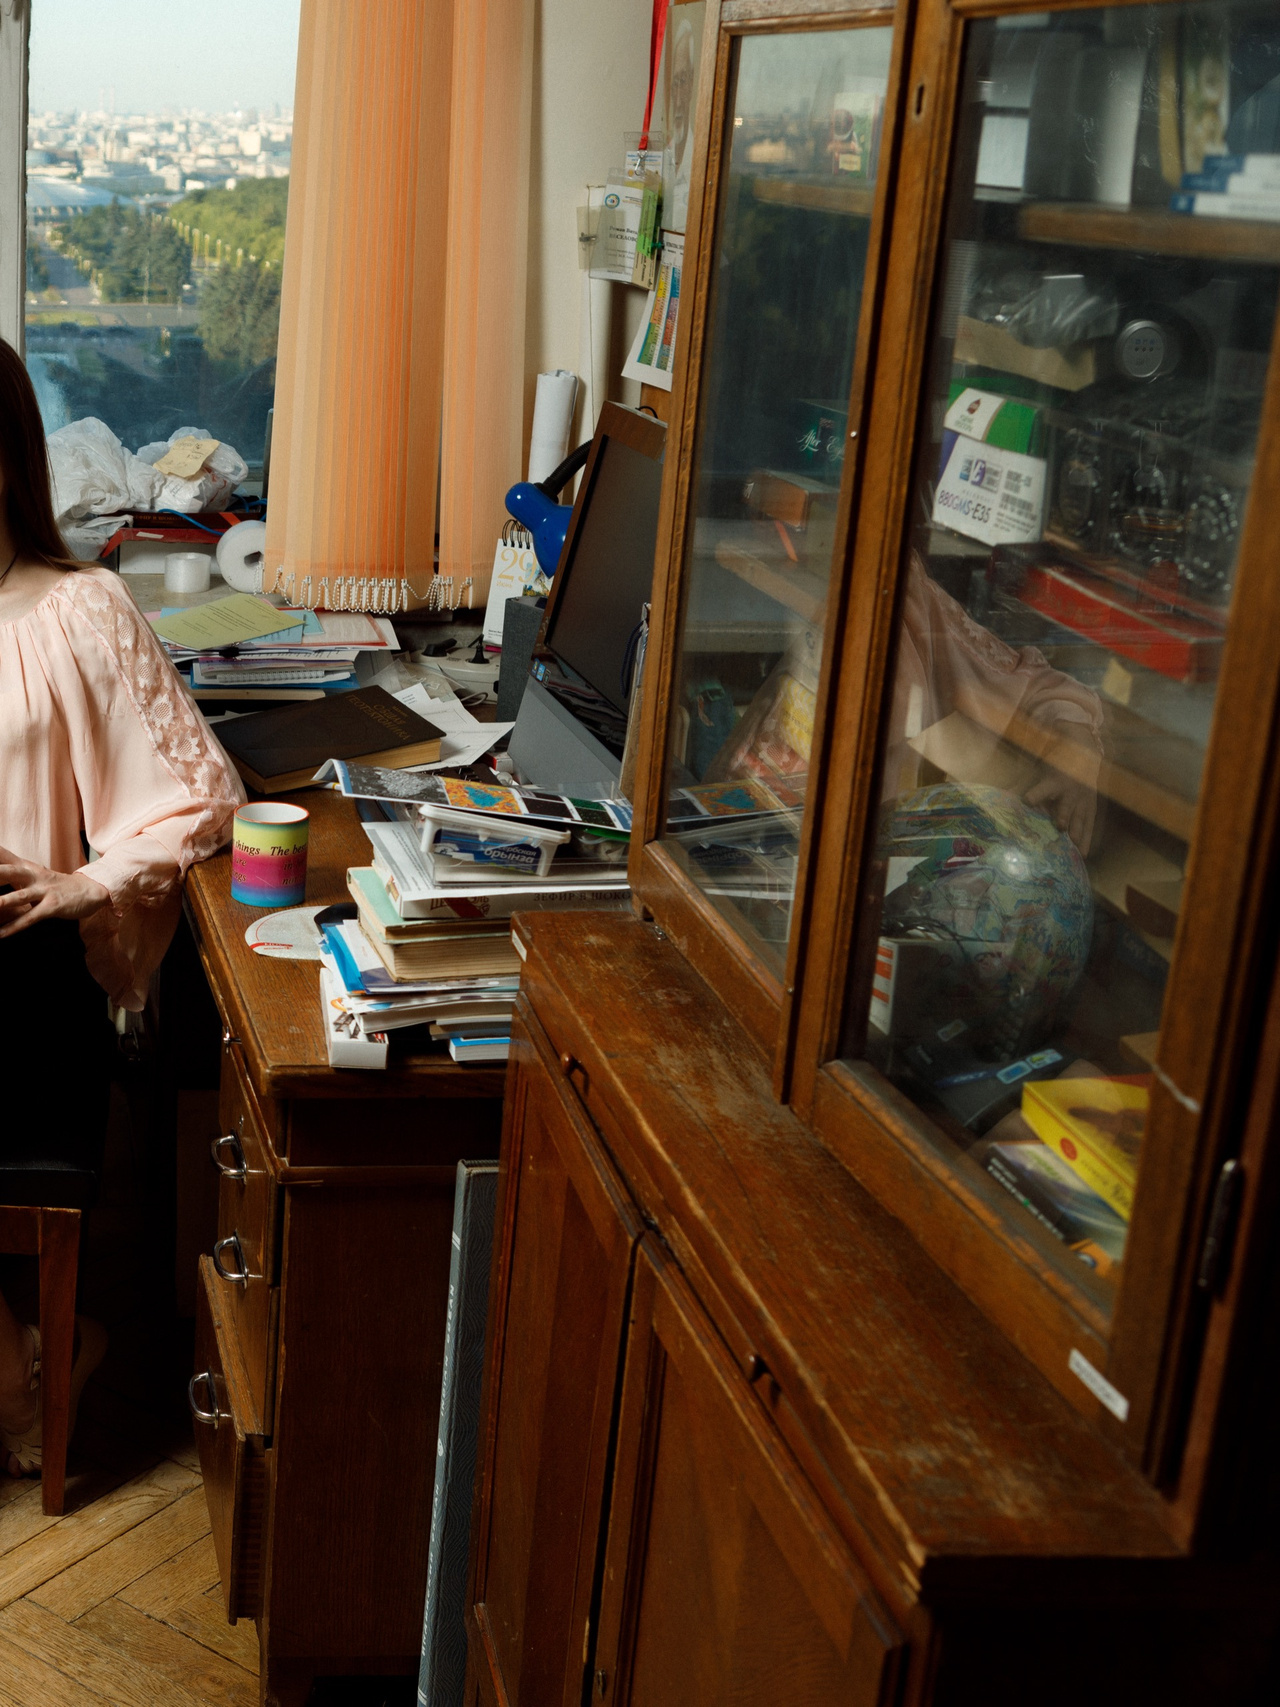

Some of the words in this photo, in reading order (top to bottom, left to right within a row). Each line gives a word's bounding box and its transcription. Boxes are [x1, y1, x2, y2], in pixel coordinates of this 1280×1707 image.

[938, 490, 991, 524] 880GMS-E35
[498, 548, 536, 583] 29
[270, 846, 290, 856] The
[484, 848, 535, 864] брынза
[500, 846, 537, 856] ербская
